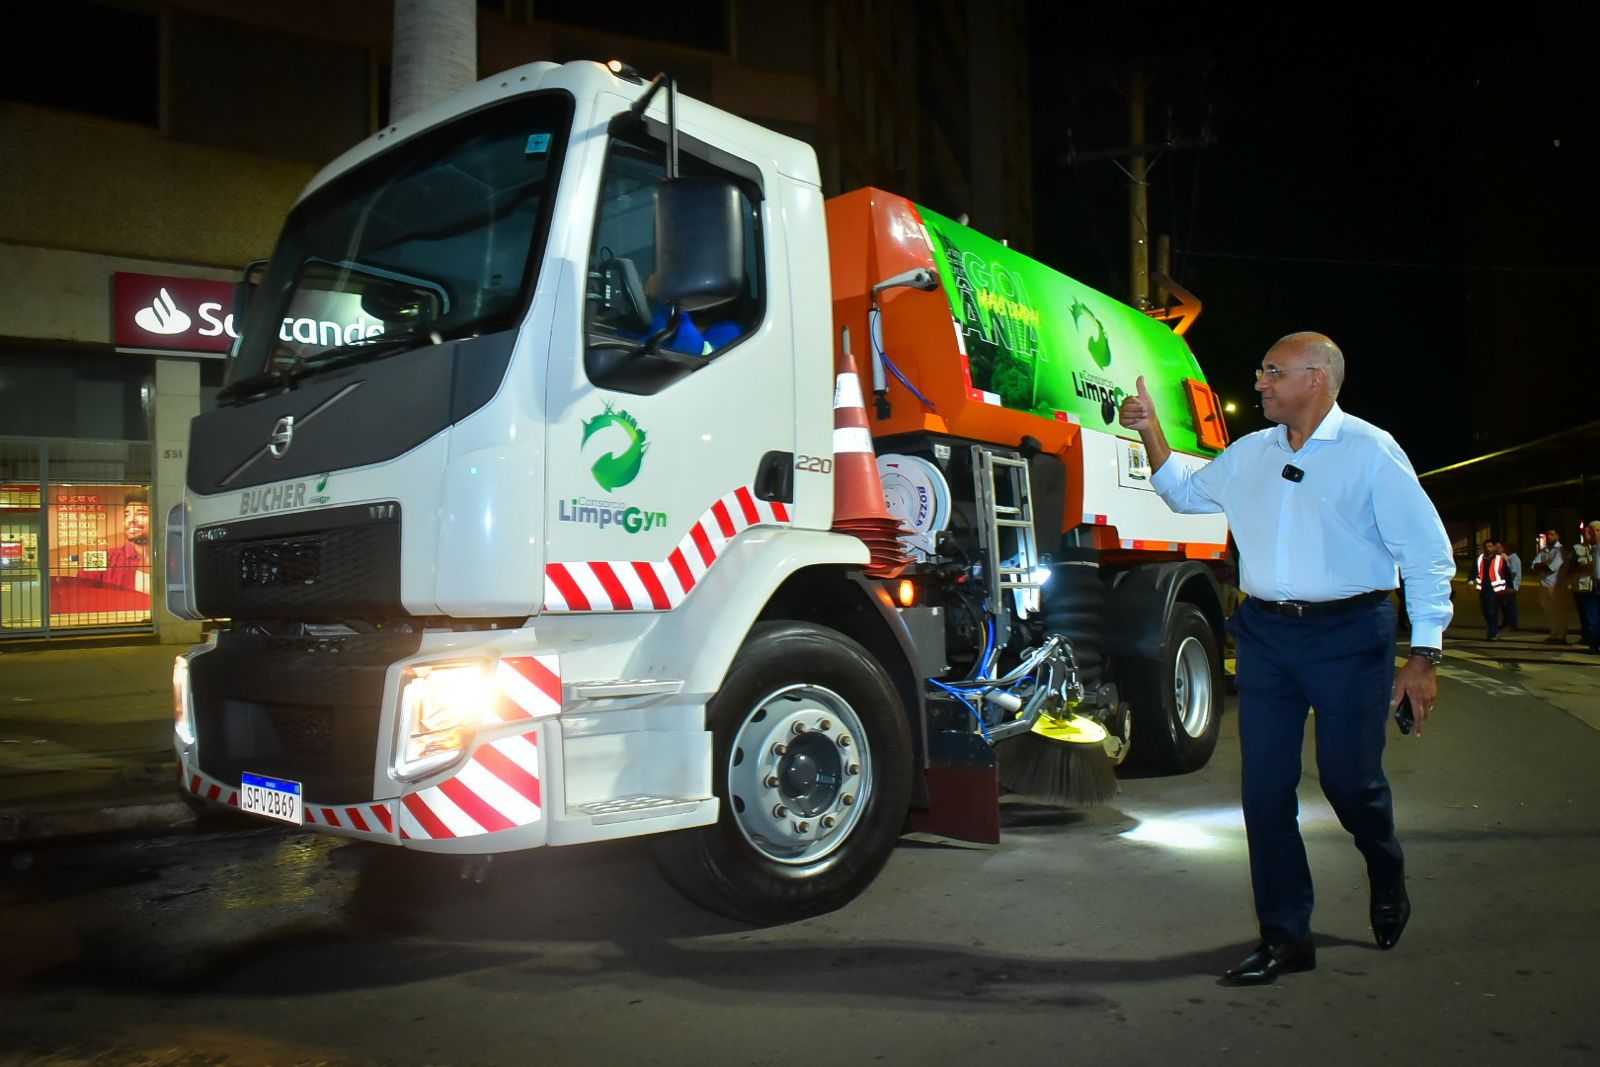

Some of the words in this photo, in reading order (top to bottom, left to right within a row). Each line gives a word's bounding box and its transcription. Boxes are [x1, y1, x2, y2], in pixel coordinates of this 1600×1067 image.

[795, 454, 832, 474] 220
[239, 482, 306, 515] BUCHER
[915, 485, 927, 527] BOZZA
[247, 786, 294, 819] SFV2B69
